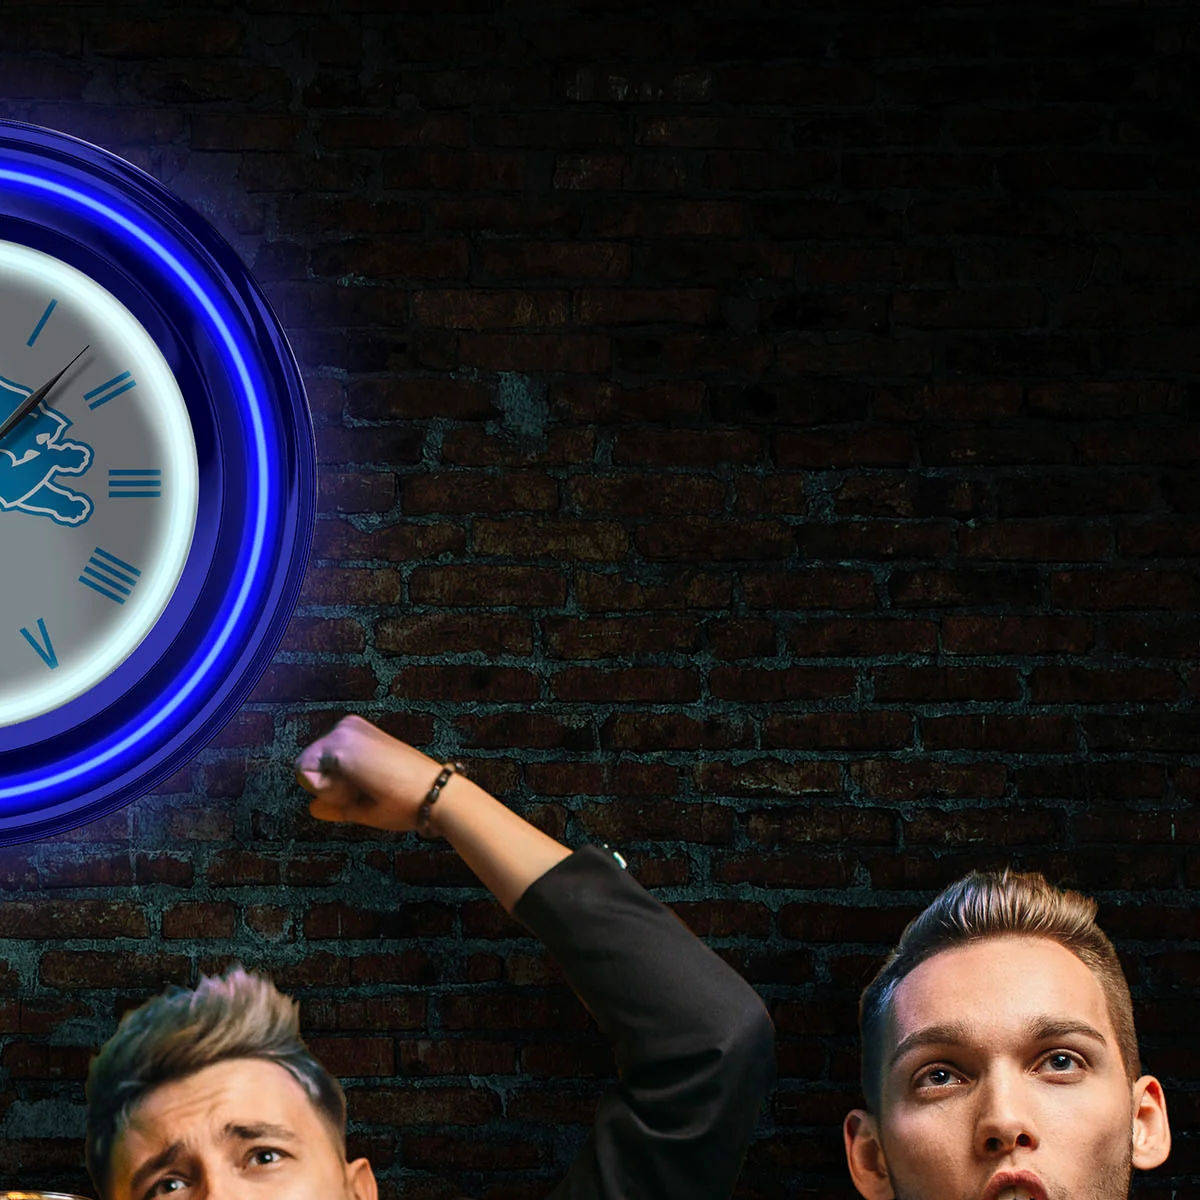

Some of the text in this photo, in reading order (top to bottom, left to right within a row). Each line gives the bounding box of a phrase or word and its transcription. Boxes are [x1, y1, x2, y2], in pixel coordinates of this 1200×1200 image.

[26, 298, 58, 348] I
[83, 370, 137, 411] II
[108, 469, 162, 499] III
[77, 546, 142, 605] IIII
[19, 617, 59, 670] V
